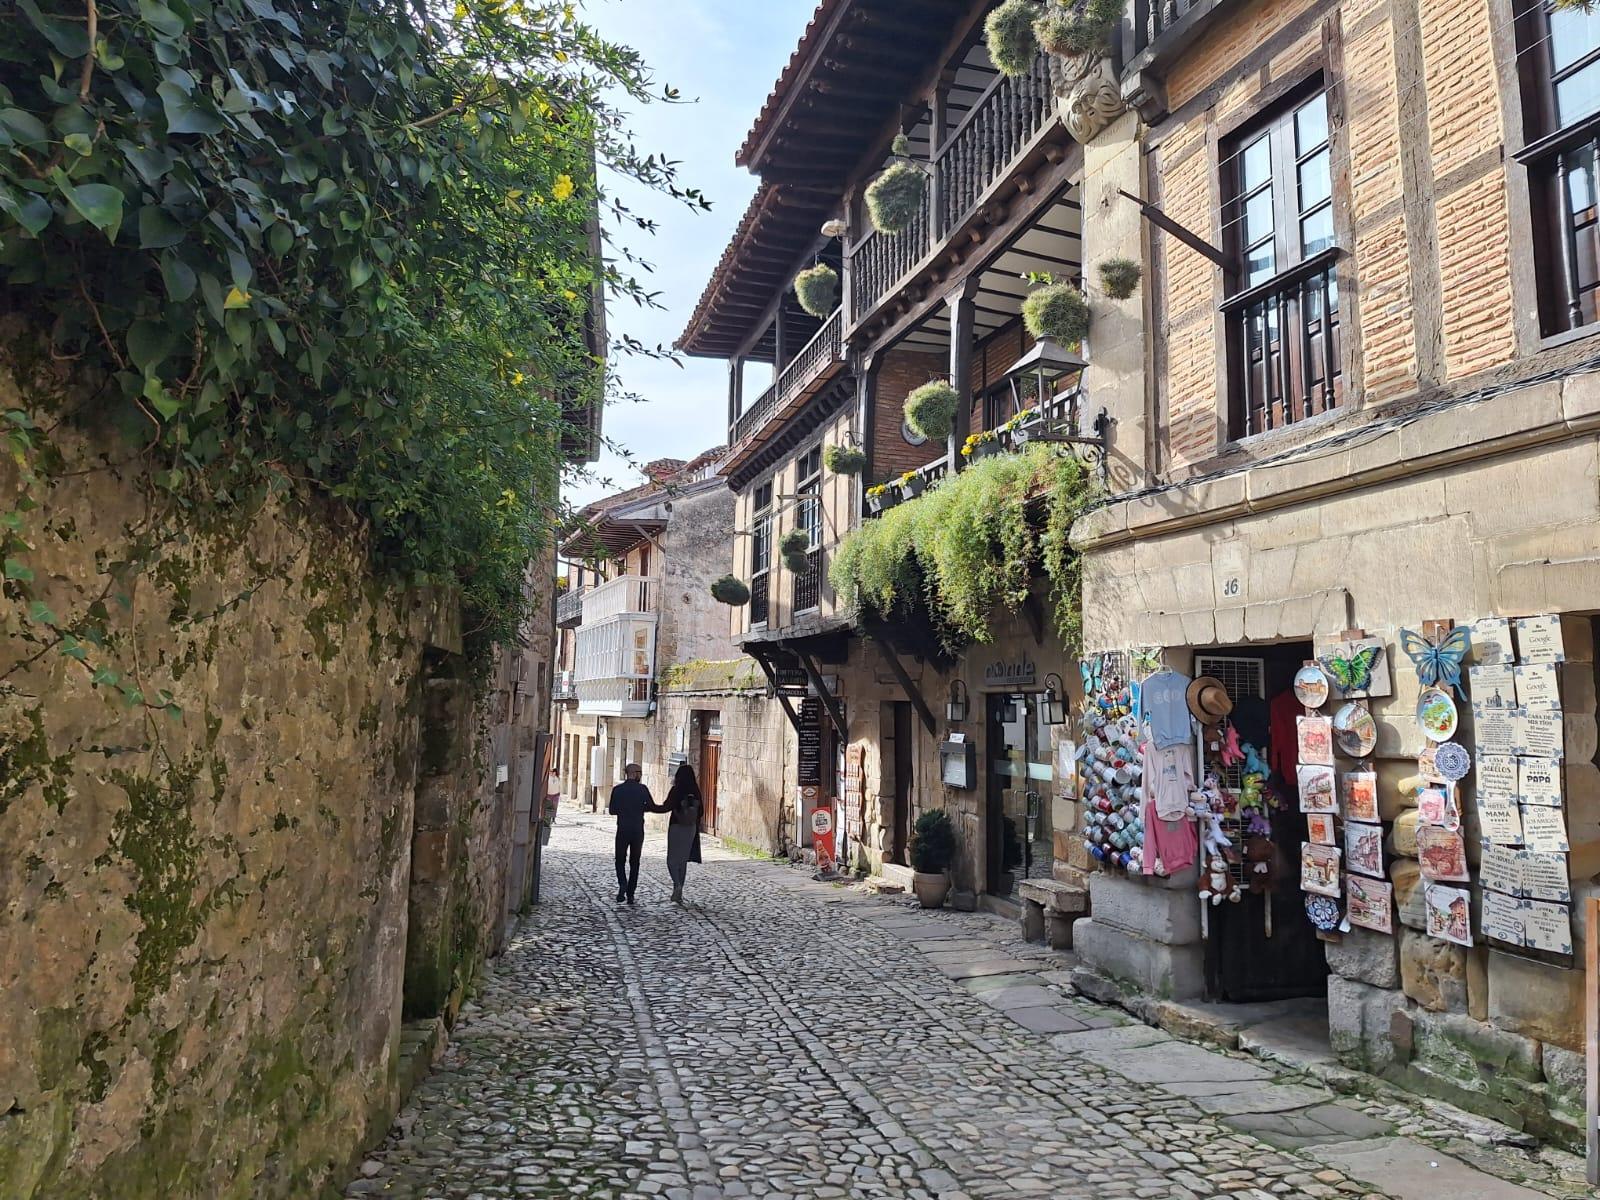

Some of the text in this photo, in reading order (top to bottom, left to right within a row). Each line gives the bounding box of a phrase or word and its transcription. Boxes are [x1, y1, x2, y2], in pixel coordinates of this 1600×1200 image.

[1224, 578, 1238, 595] 16
[1529, 634, 1552, 645] Google
[1526, 682, 1548, 691] Google
